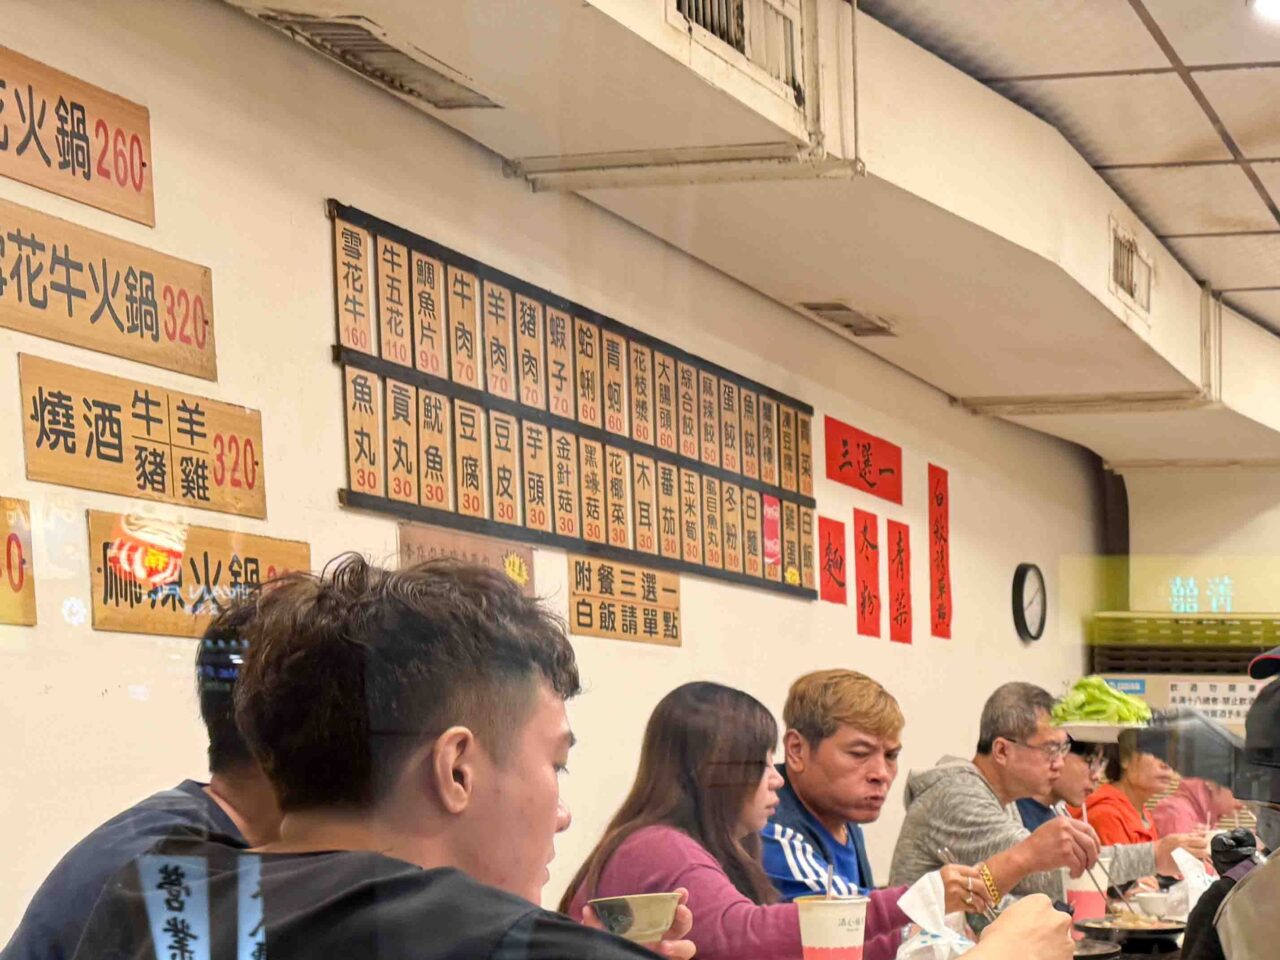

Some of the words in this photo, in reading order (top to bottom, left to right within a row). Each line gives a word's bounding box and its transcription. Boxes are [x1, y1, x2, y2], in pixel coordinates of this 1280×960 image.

[94, 118, 144, 193] 260
[342, 228, 365, 323] 雪花牛
[382, 244, 404, 338] 牛五花
[163, 284, 207, 350] 320
[416, 258, 437, 351] 鯛魚片
[453, 272, 473, 359] 牛肉
[344, 326, 367, 349] 160
[386, 339, 407, 362] 110
[488, 288, 508, 373] 羊肉
[520, 301, 538, 384] 豬肉
[549, 312, 567, 393] 蝦子
[420, 350, 440, 372] 90
[456, 361, 474, 382] 70
[605, 338, 622, 413] 青蚵
[492, 375, 508, 393] 70
[524, 386, 539, 405] 70
[553, 396, 568, 414] 70
[658, 359, 673, 432] 大腸頭
[681, 366, 694, 438] 綜合餃
[352, 374, 376, 466] 魚丸
[392, 384, 413, 475] 貢丸
[582, 404, 596, 421] 60
[608, 415, 622, 432] 60
[636, 424, 649, 440] 60
[723, 383, 736, 450] 蛋餃
[743, 394, 756, 458] 魚餃
[31, 386, 124, 465] 燒酒
[131, 389, 164, 436] 牛
[176, 402, 207, 446] 羊
[213, 433, 257, 490] 320
[423, 394, 445, 483] 魷魚
[459, 405, 479, 491] 豆腐
[494, 417, 513, 500] 豆皮
[660, 435, 673, 449] 60
[683, 441, 696, 456] 60
[704, 448, 716, 463] 50
[135, 445, 167, 494] 豬
[180, 456, 211, 501] 雞
[357, 468, 378, 490] 30
[526, 426, 545, 507] 芋頭
[556, 435, 573, 514] 金針菇
[725, 453, 736, 469] 50
[838, 439, 895, 489] 三選一
[393, 477, 413, 498] 30
[425, 484, 445, 503] 30
[462, 494, 480, 512] 30
[609, 452, 625, 526] 花椰菜
[636, 461, 652, 533] 木耳
[661, 466, 676, 536] 蕃茄
[684, 472, 697, 542] 玉米筍
[498, 502, 514, 521] 30
[530, 508, 545, 526] 30
[559, 517, 574, 534] 30
[586, 523, 601, 539] 30
[725, 486, 738, 551] 冬粉
[612, 528, 626, 544] 30
[639, 534, 653, 550] 30
[664, 539, 677, 554] 30
[686, 545, 698, 559] 30
[708, 550, 720, 564] 30
[574, 559, 677, 603] 附餐三選一
[727, 553, 739, 568] 30
[576, 598, 679, 640] 白飯請單點
